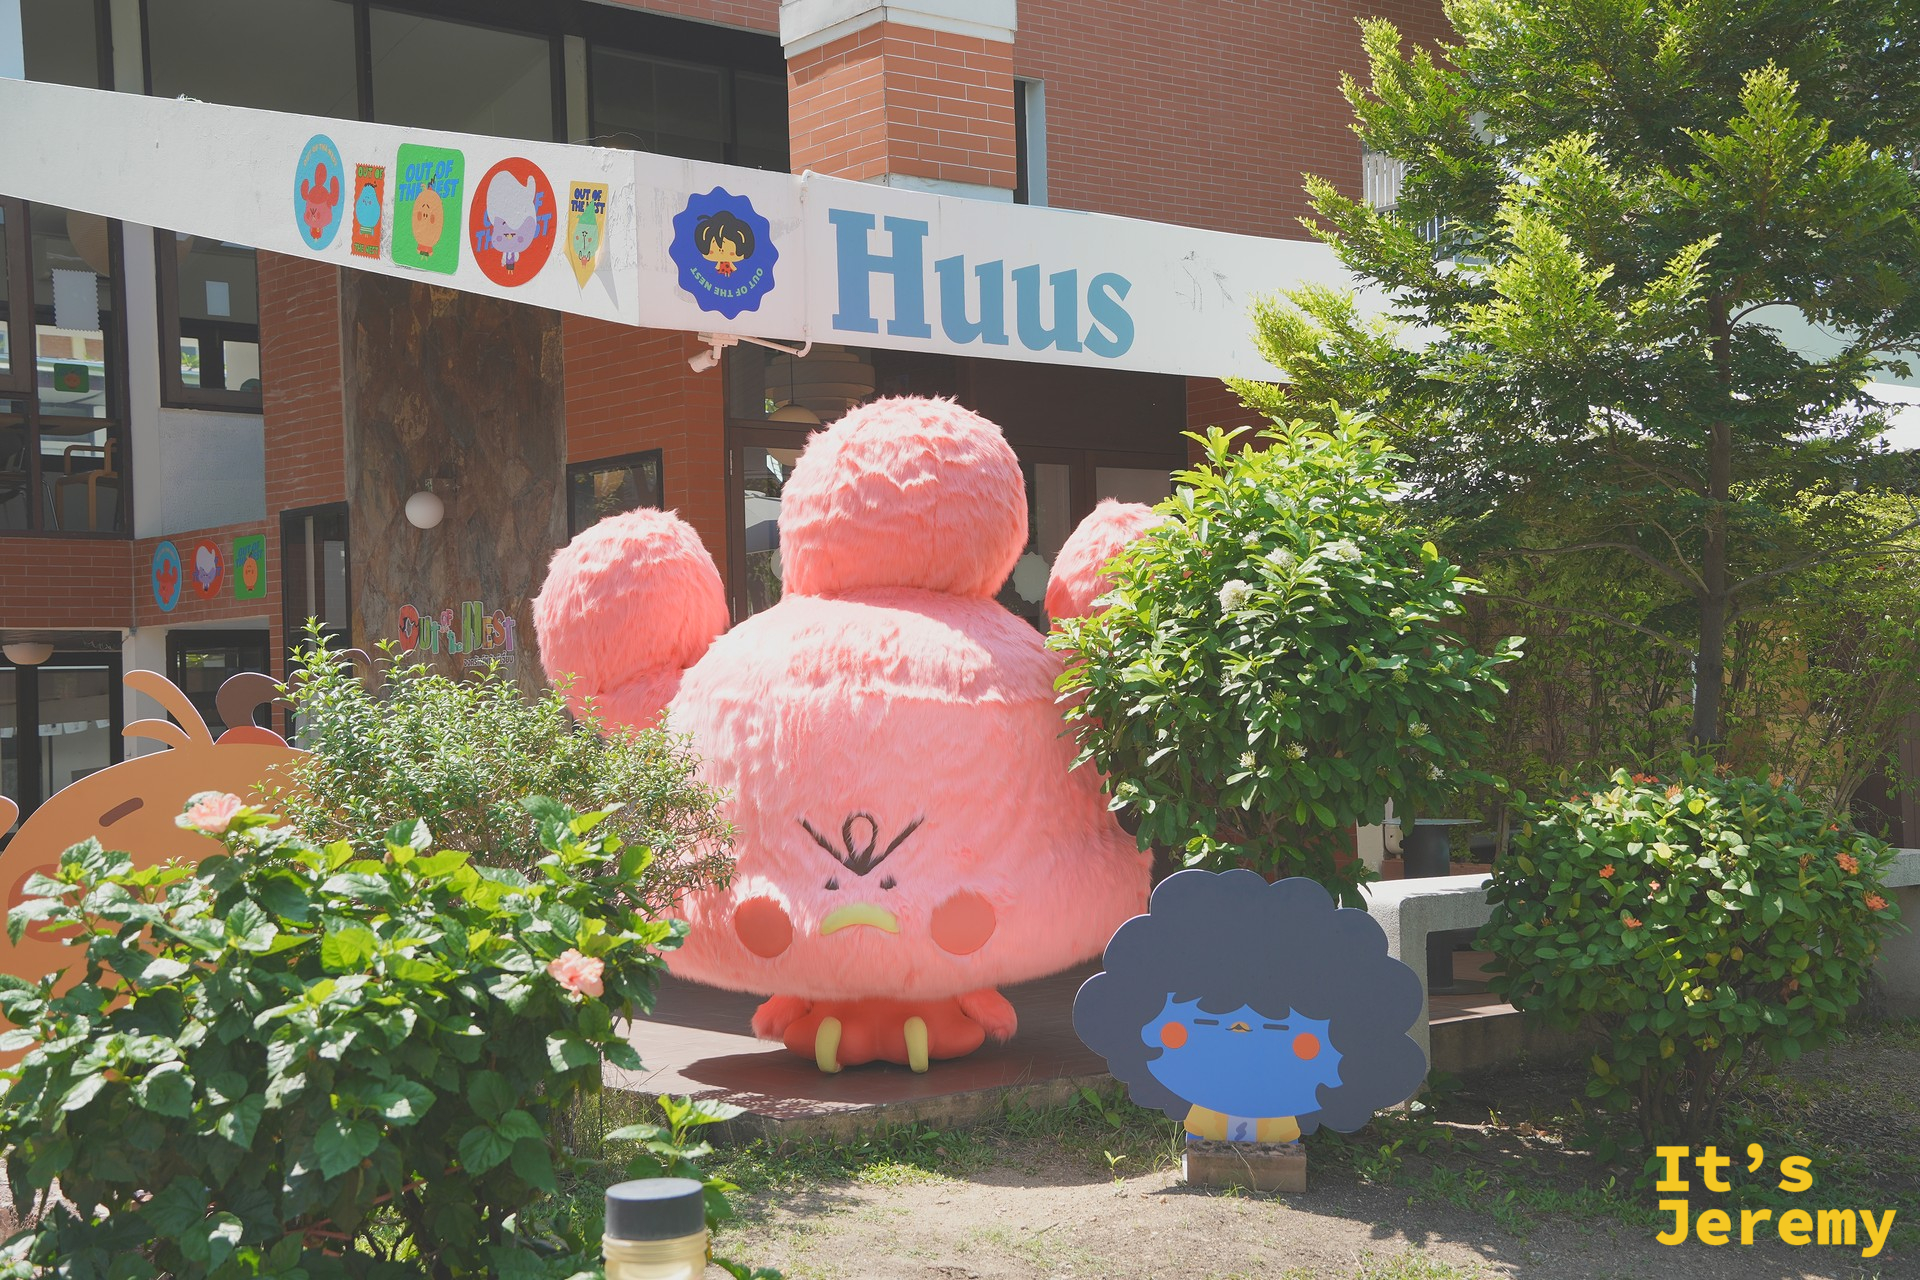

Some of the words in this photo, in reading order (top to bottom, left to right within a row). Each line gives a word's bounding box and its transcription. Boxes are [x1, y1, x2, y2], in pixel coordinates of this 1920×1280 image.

[357, 165, 373, 178] OUT
[374, 167, 384, 180] OF
[405, 162, 433, 182] OUT
[436, 160, 454, 179] OF
[574, 188, 591, 201] OUT
[592, 189, 603, 201] OF
[571, 200, 585, 212] THE
[690, 266, 713, 291] NEST
[748, 267, 764, 290] OUT
[828, 208, 1135, 359] Huus
[713, 286, 734, 298] THE
[735, 286, 748, 297] OF
